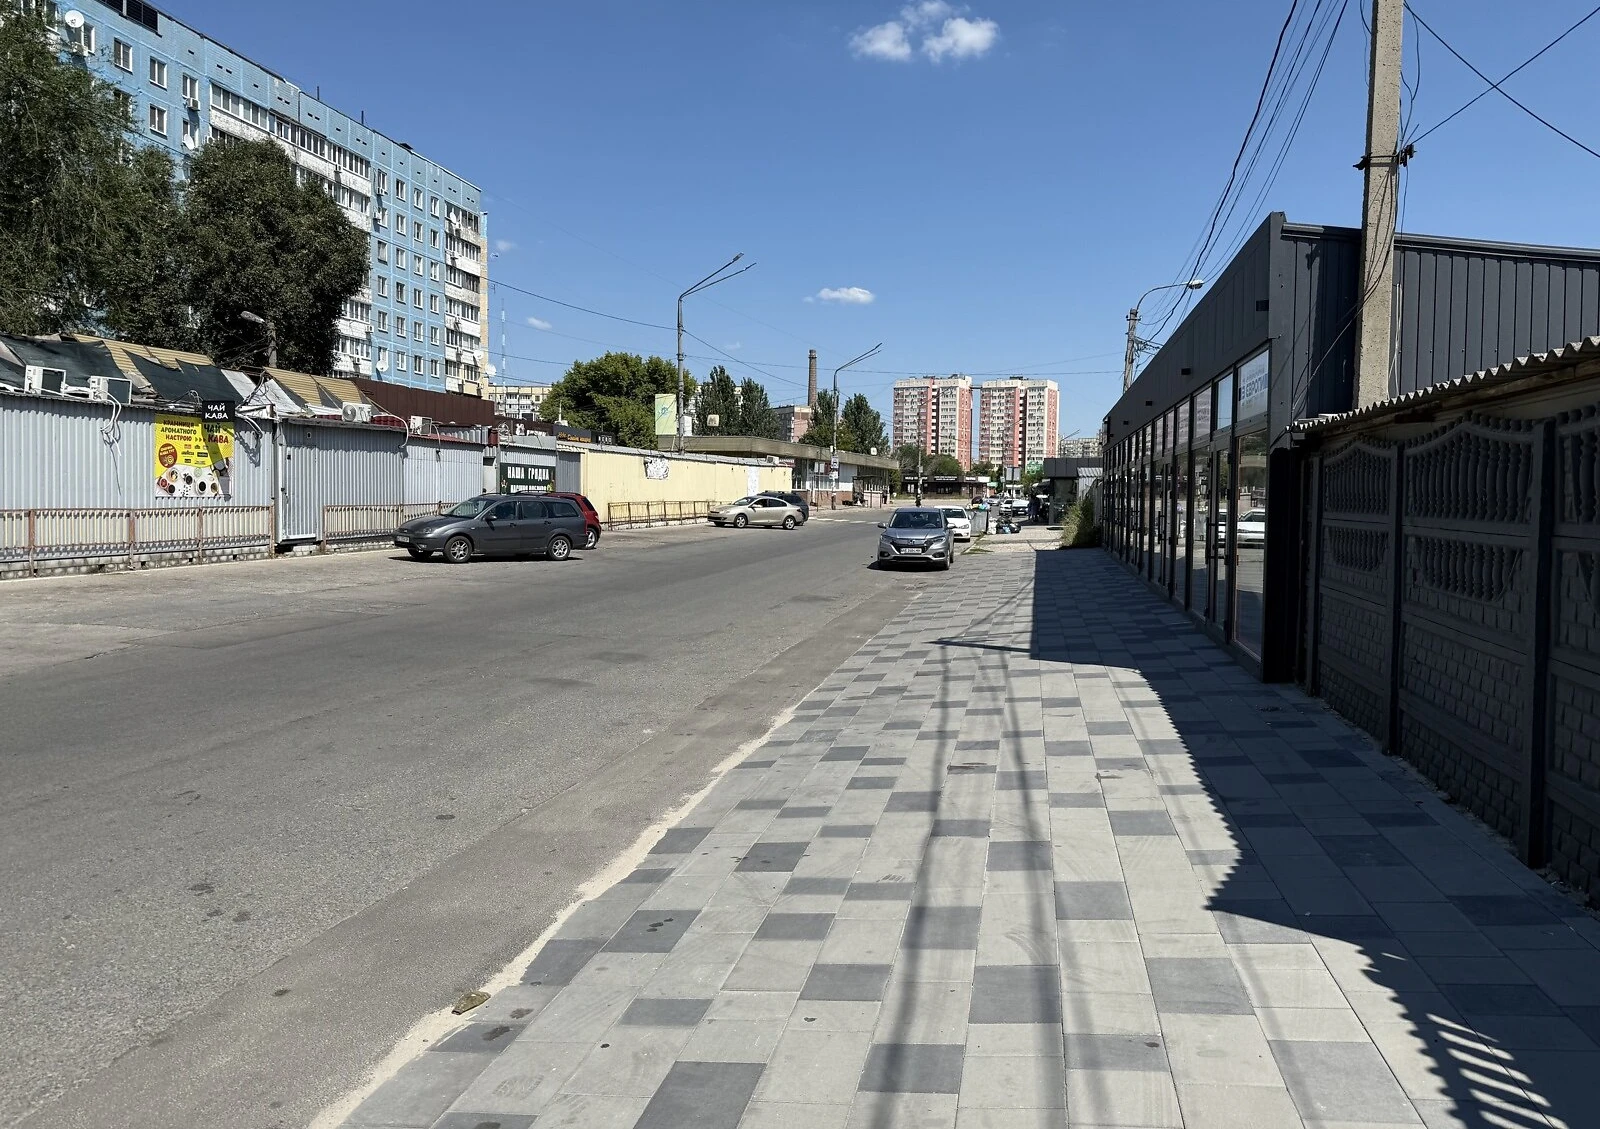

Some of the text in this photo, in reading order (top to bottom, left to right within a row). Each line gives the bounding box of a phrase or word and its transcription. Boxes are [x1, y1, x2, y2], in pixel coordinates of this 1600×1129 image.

[207, 403, 225, 412] ЧАЙ
[160, 426, 197, 435] АРОМАТНОГО
[204, 422, 221, 434] ЧАЙ
[165, 434, 192, 442] НАСТРОЮ
[207, 434, 229, 444] КАВА
[507, 466, 549, 482] НАША ГРЯДКА
